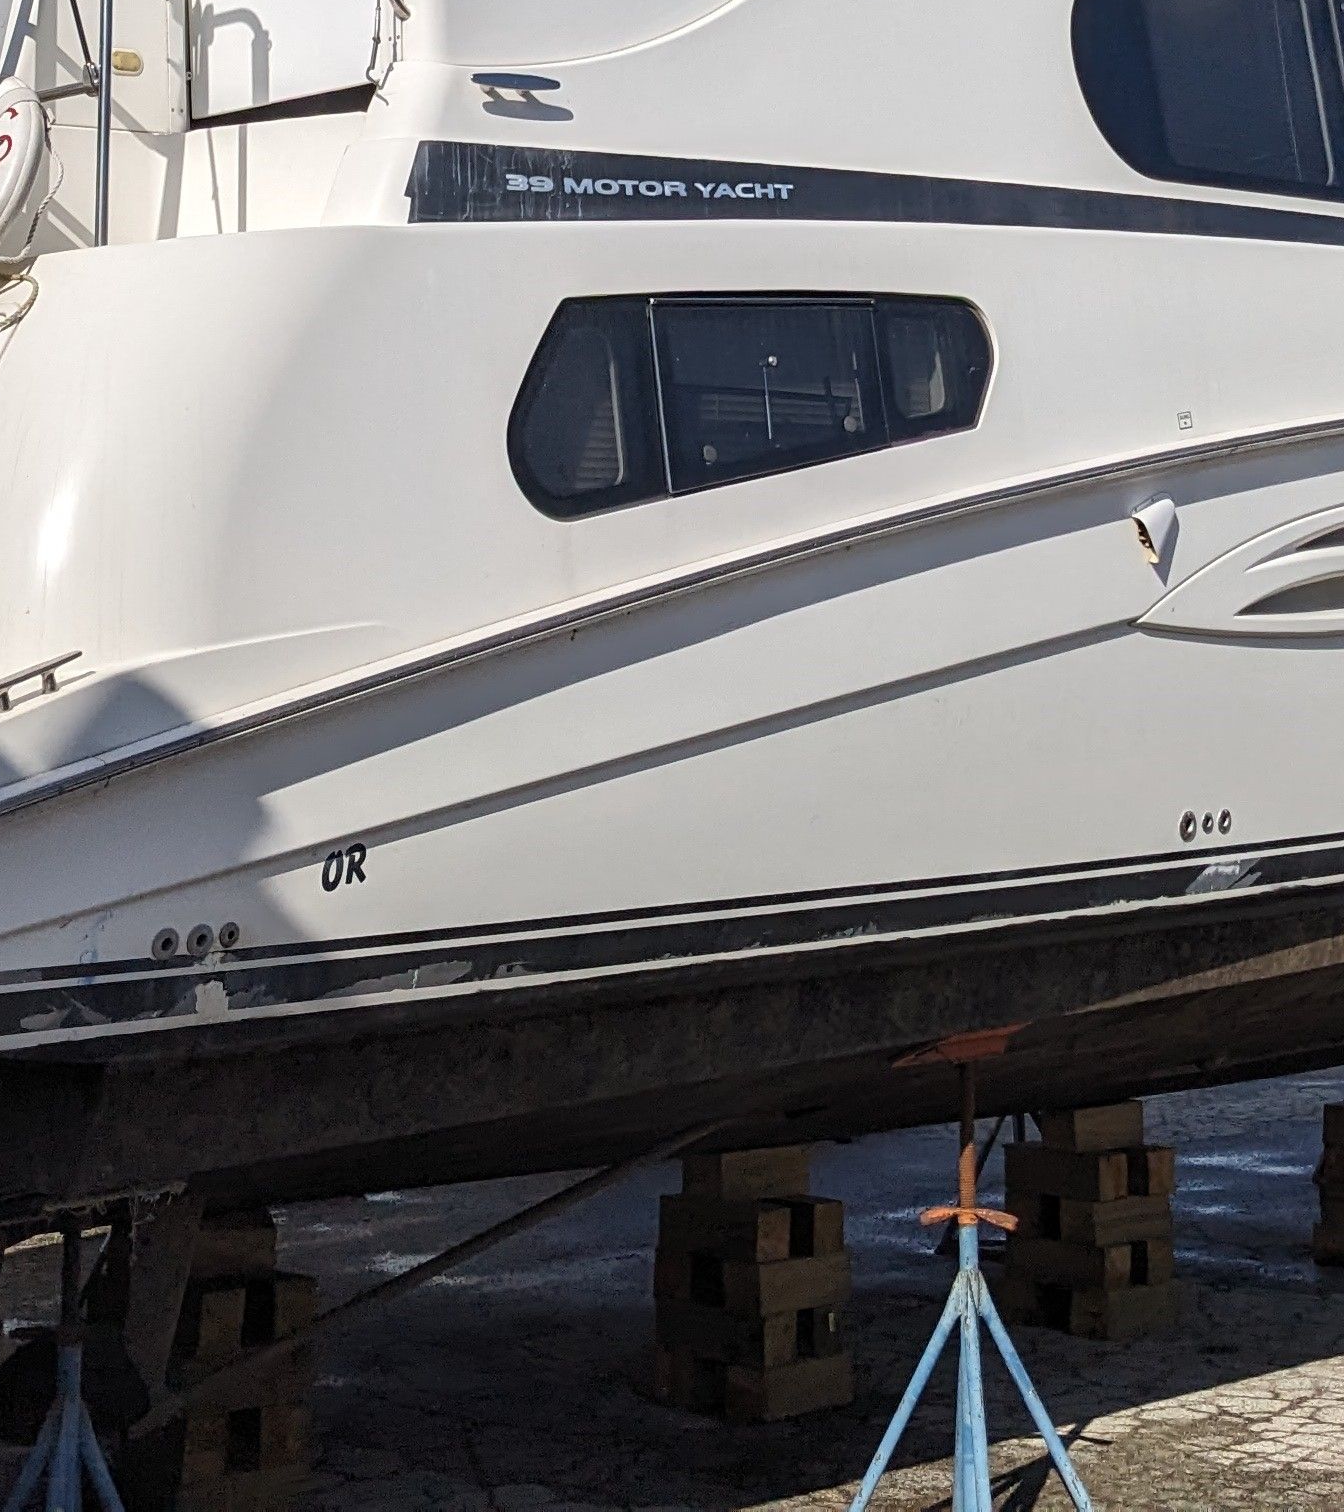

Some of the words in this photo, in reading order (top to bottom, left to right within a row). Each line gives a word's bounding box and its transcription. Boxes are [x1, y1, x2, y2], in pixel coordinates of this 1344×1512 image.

[505, 173, 554, 193] 39
[563, 177, 688, 198] MOTOR
[693, 181, 795, 201] YACHT
[321, 842, 368, 892] OR
